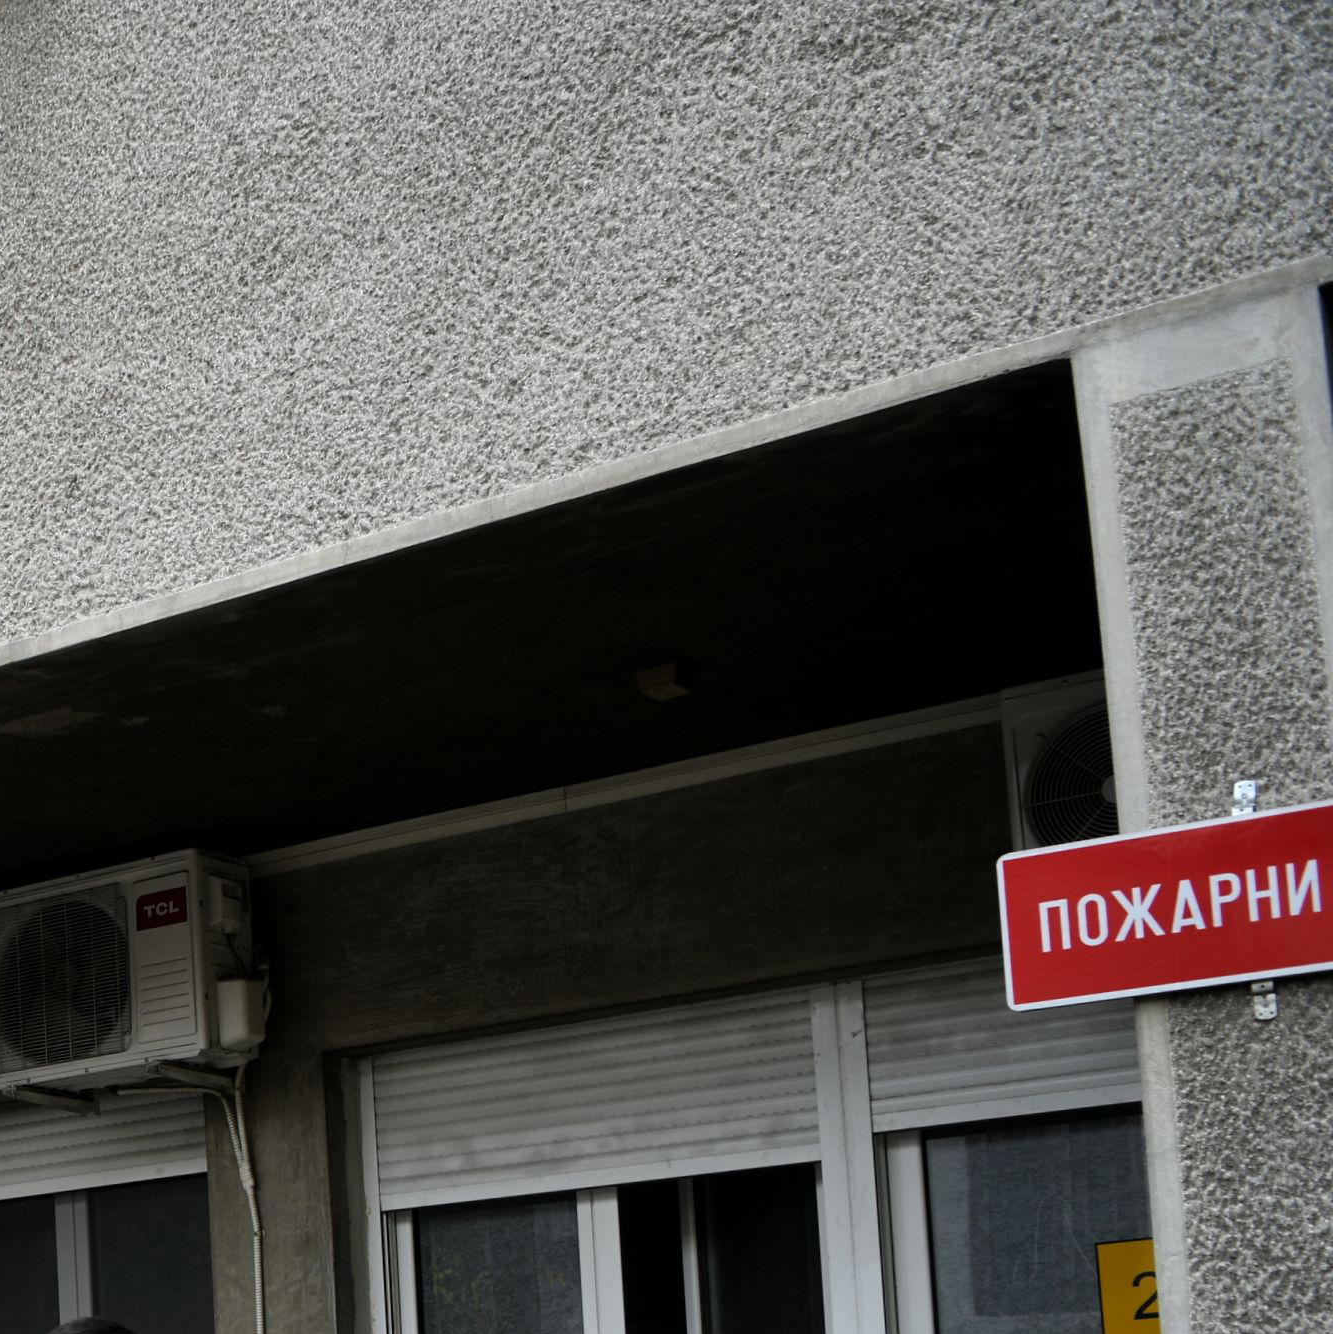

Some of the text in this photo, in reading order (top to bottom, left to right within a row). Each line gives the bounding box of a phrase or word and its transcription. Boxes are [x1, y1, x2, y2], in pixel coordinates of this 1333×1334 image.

[143, 900, 180, 918] TCL
[1039, 859, 1322, 953] ПОЖАРНИ
[1132, 1271, 1160, 1320] 2
